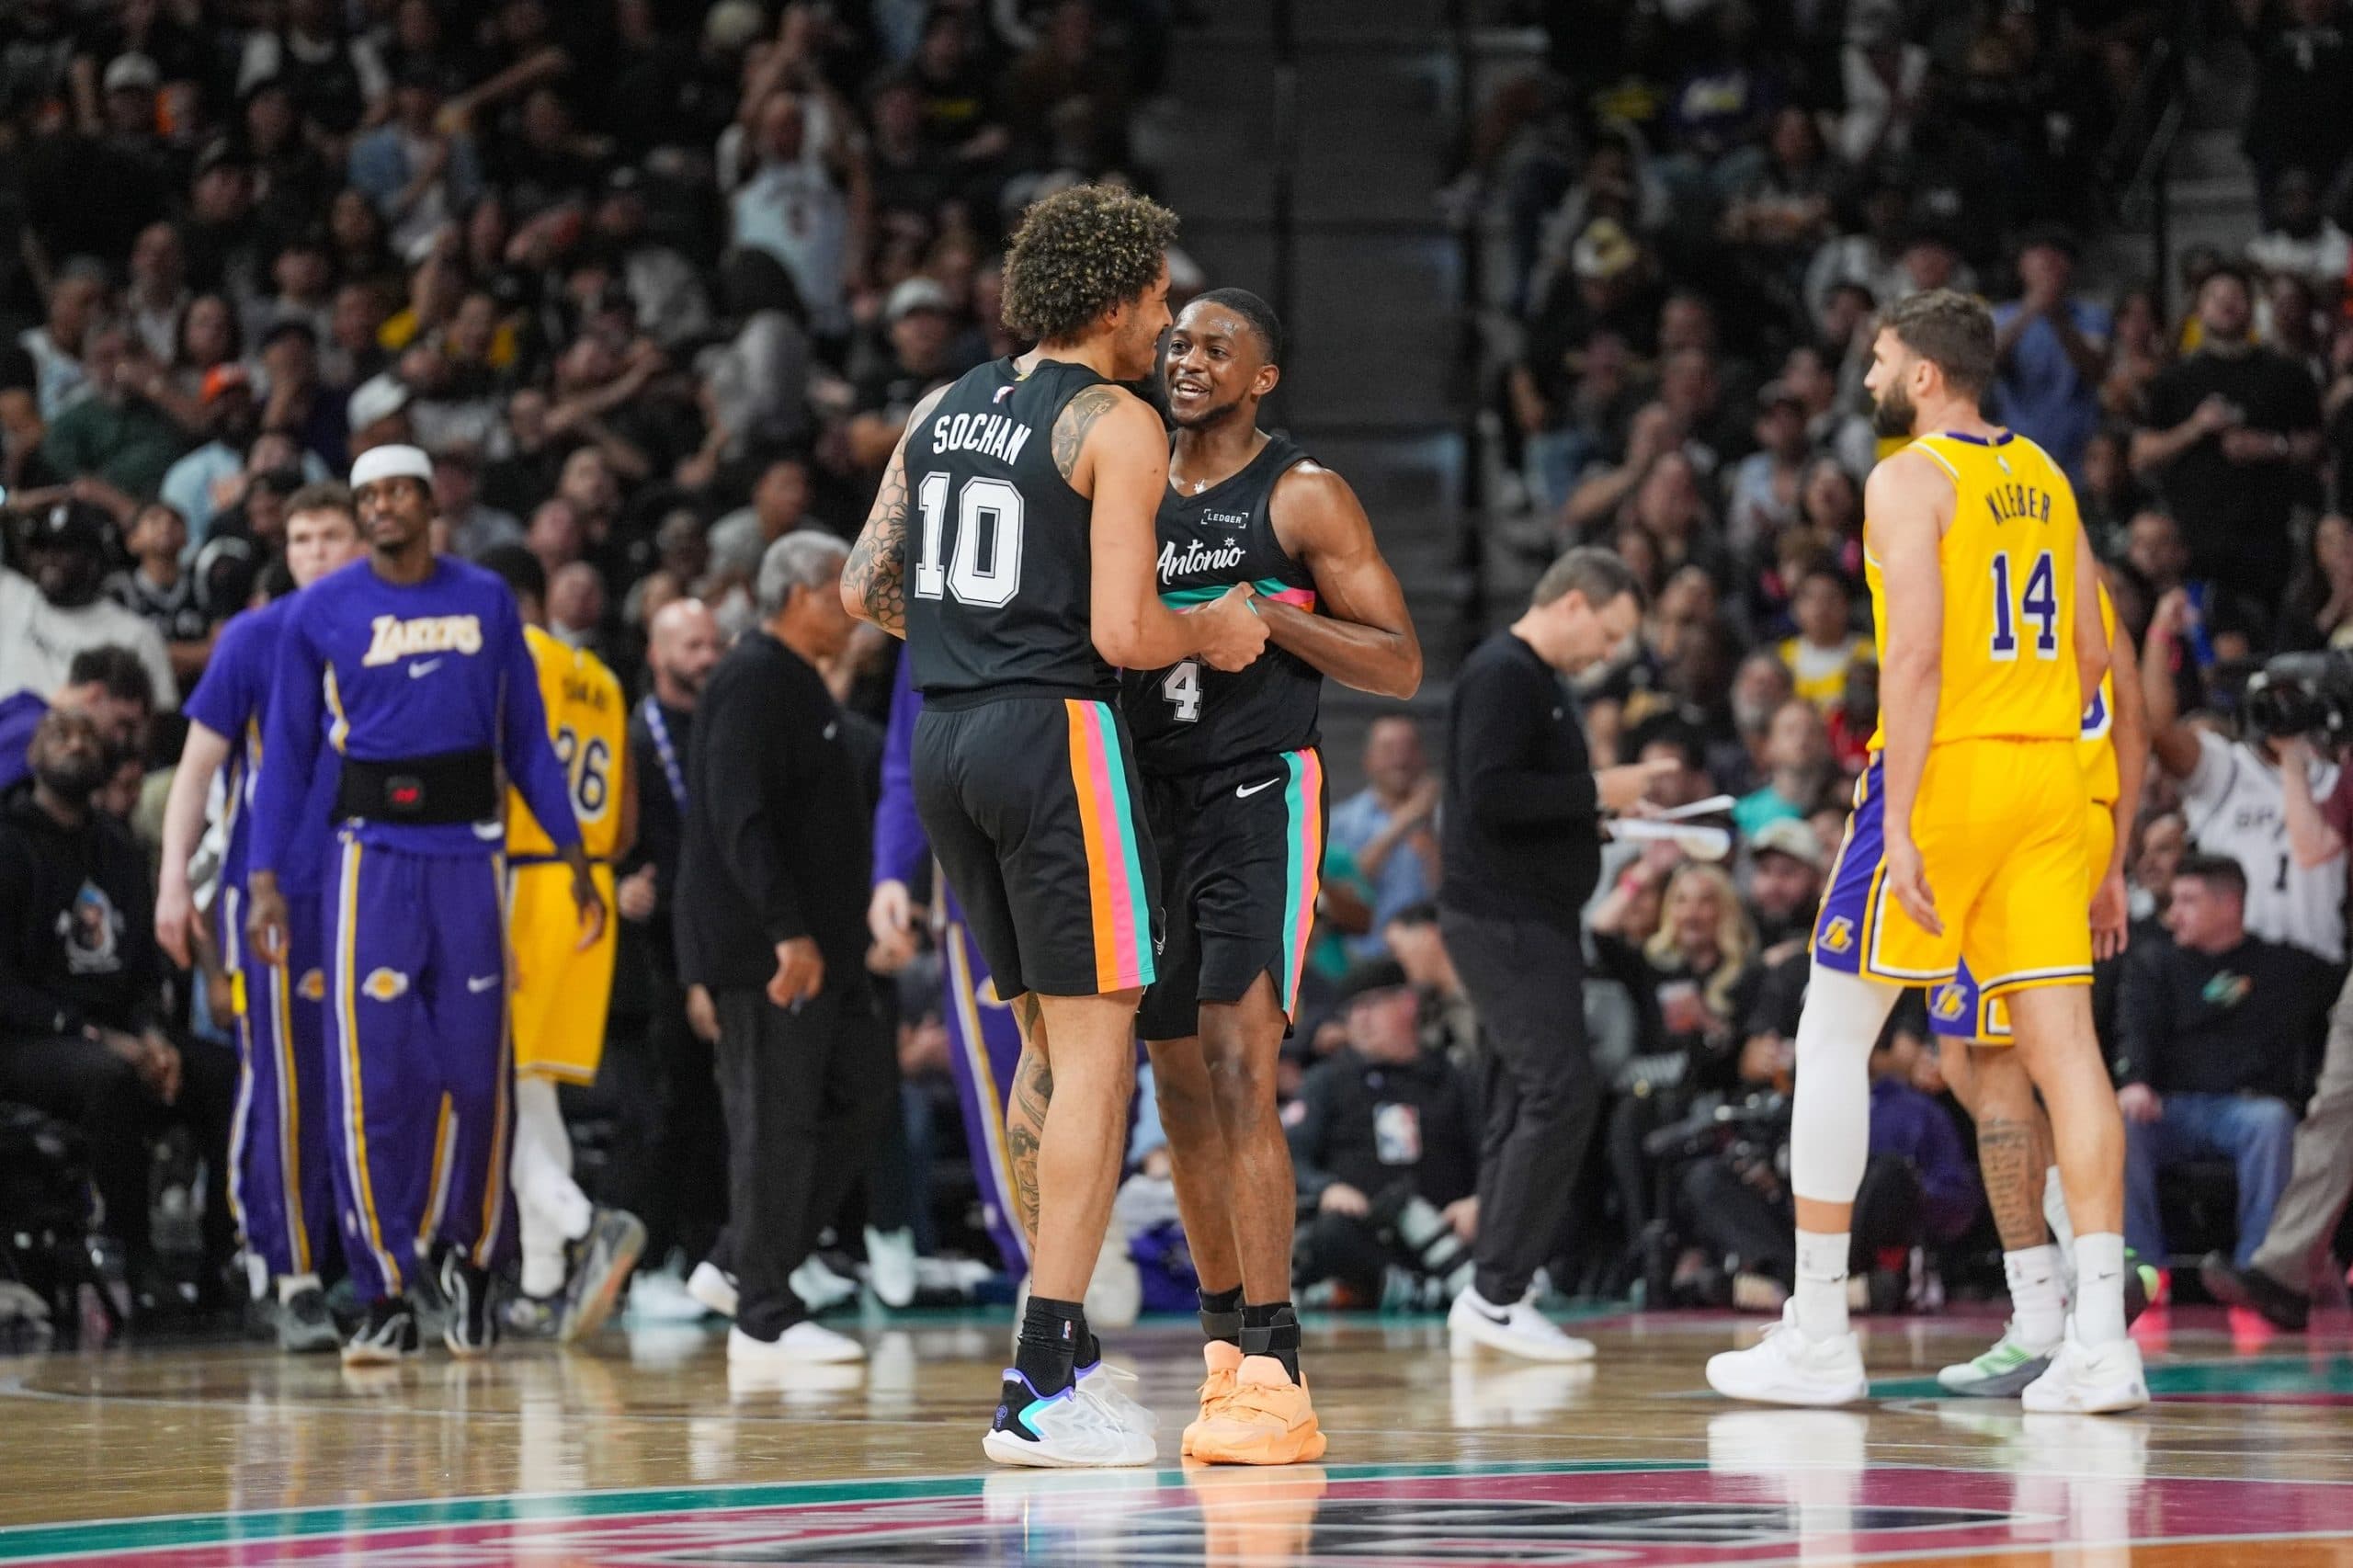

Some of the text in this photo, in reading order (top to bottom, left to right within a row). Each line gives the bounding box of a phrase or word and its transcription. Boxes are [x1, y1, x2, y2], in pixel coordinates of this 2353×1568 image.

[932, 412, 1031, 466] SOCHAN
[1207, 513, 1242, 524] LEDGER
[1984, 483, 2052, 527] KLEBER
[914, 471, 1025, 609] 10
[1156, 537, 1246, 585] Antonio
[1989, 549, 2059, 662] 14
[361, 614, 483, 667] LAKERS
[1161, 659, 1204, 723] 4
